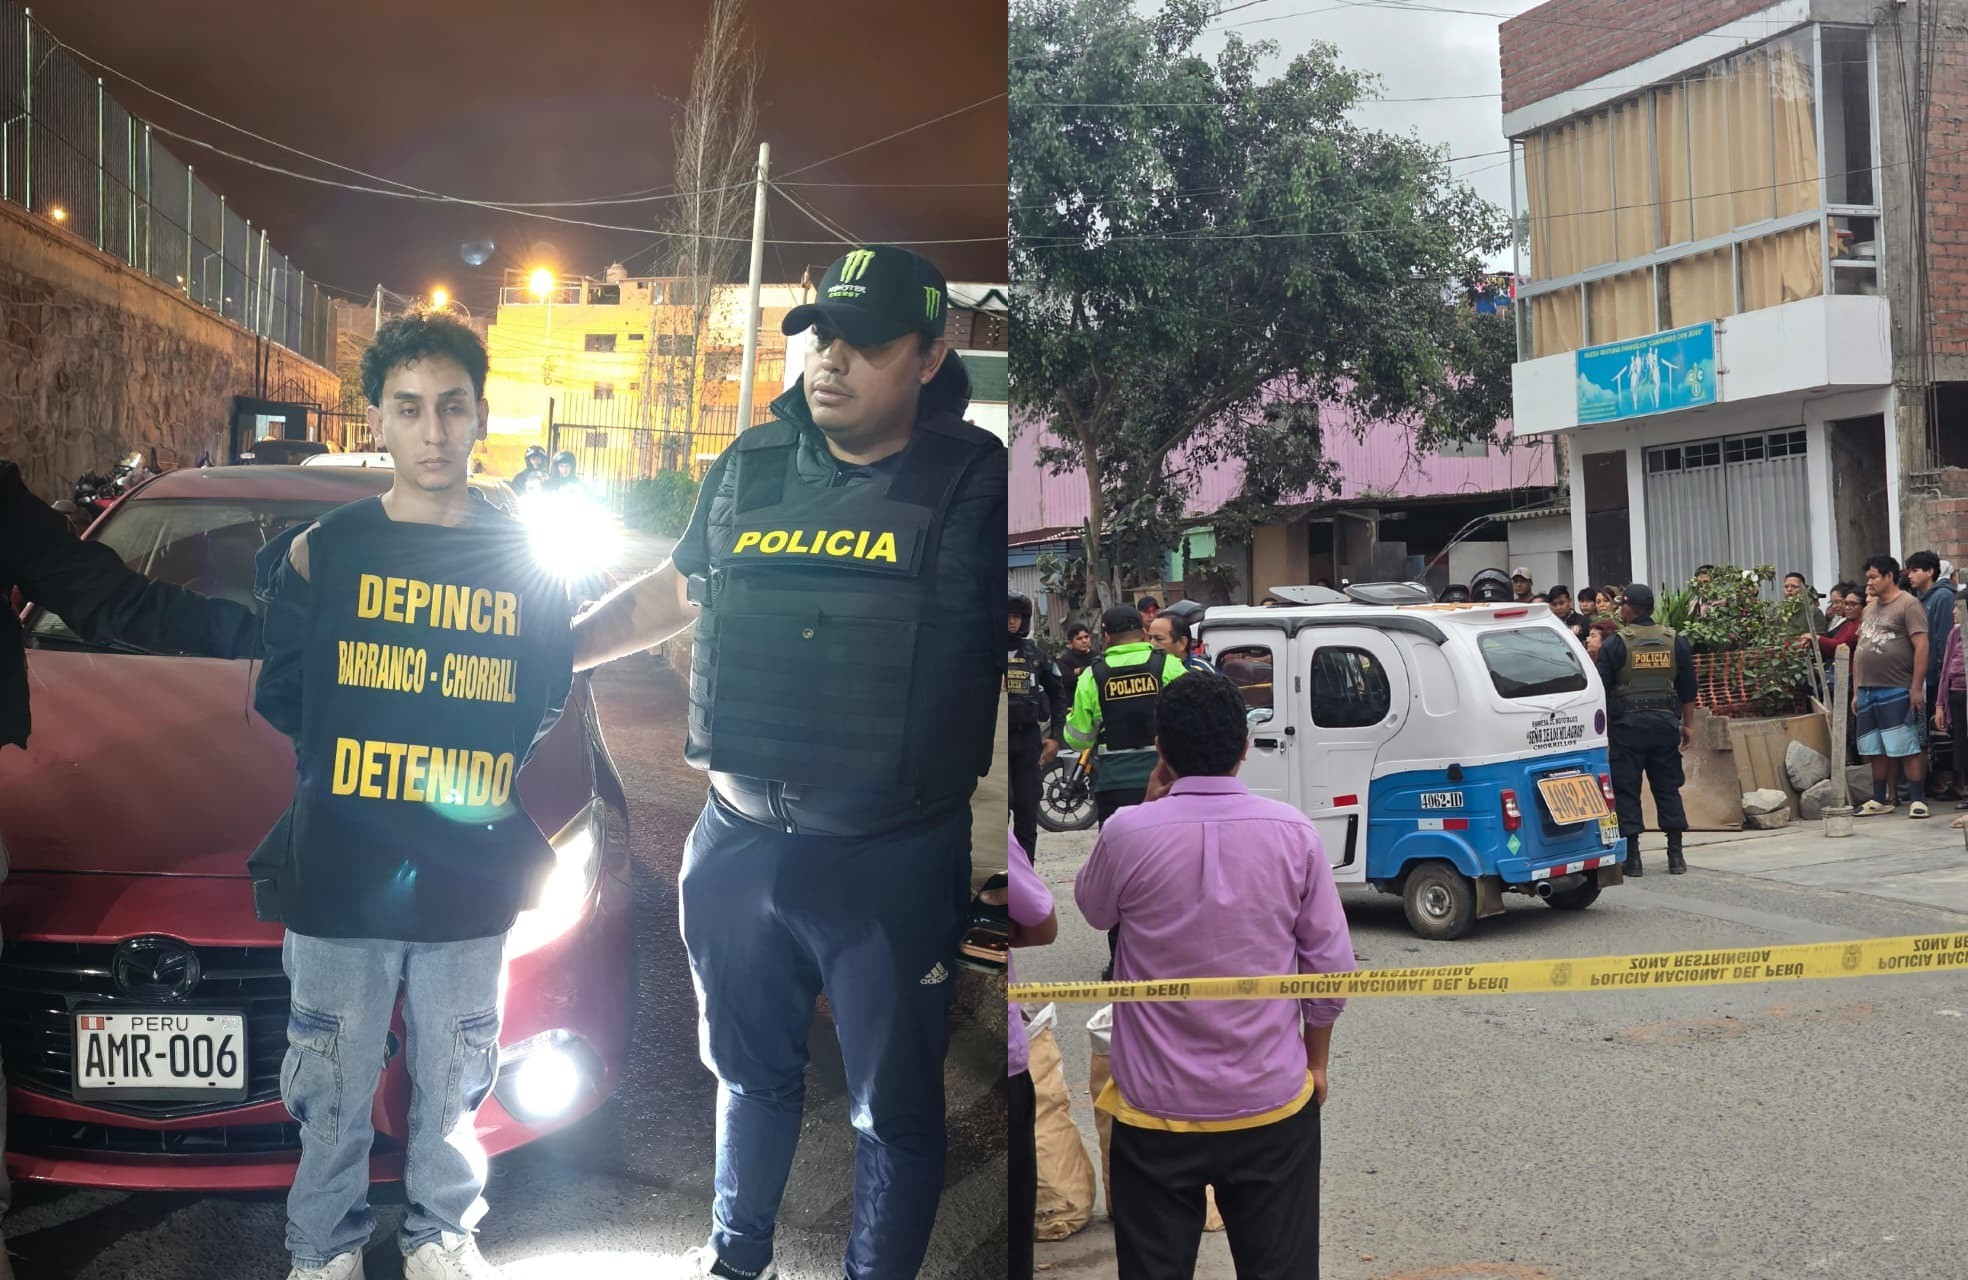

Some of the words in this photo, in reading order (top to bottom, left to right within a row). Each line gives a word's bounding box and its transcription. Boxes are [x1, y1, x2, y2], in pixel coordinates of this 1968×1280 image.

[1678, 331, 1688, 339] CON
[733, 530, 897, 562] POLICIA
[338, 640, 427, 694] BARRANCO
[1635, 653, 1669, 663] POLICIA
[1109, 677, 1156, 696] POLICIA
[1533, 740, 1577, 750] CHORRILLOS
[332, 737, 515, 808] DETENIDO
[1423, 793, 1463, 808] 4062-ID
[1546, 780, 1603, 819] 4062-ID
[131, 1016, 189, 1031] PERU
[85, 1033, 238, 1078] AMR-006
